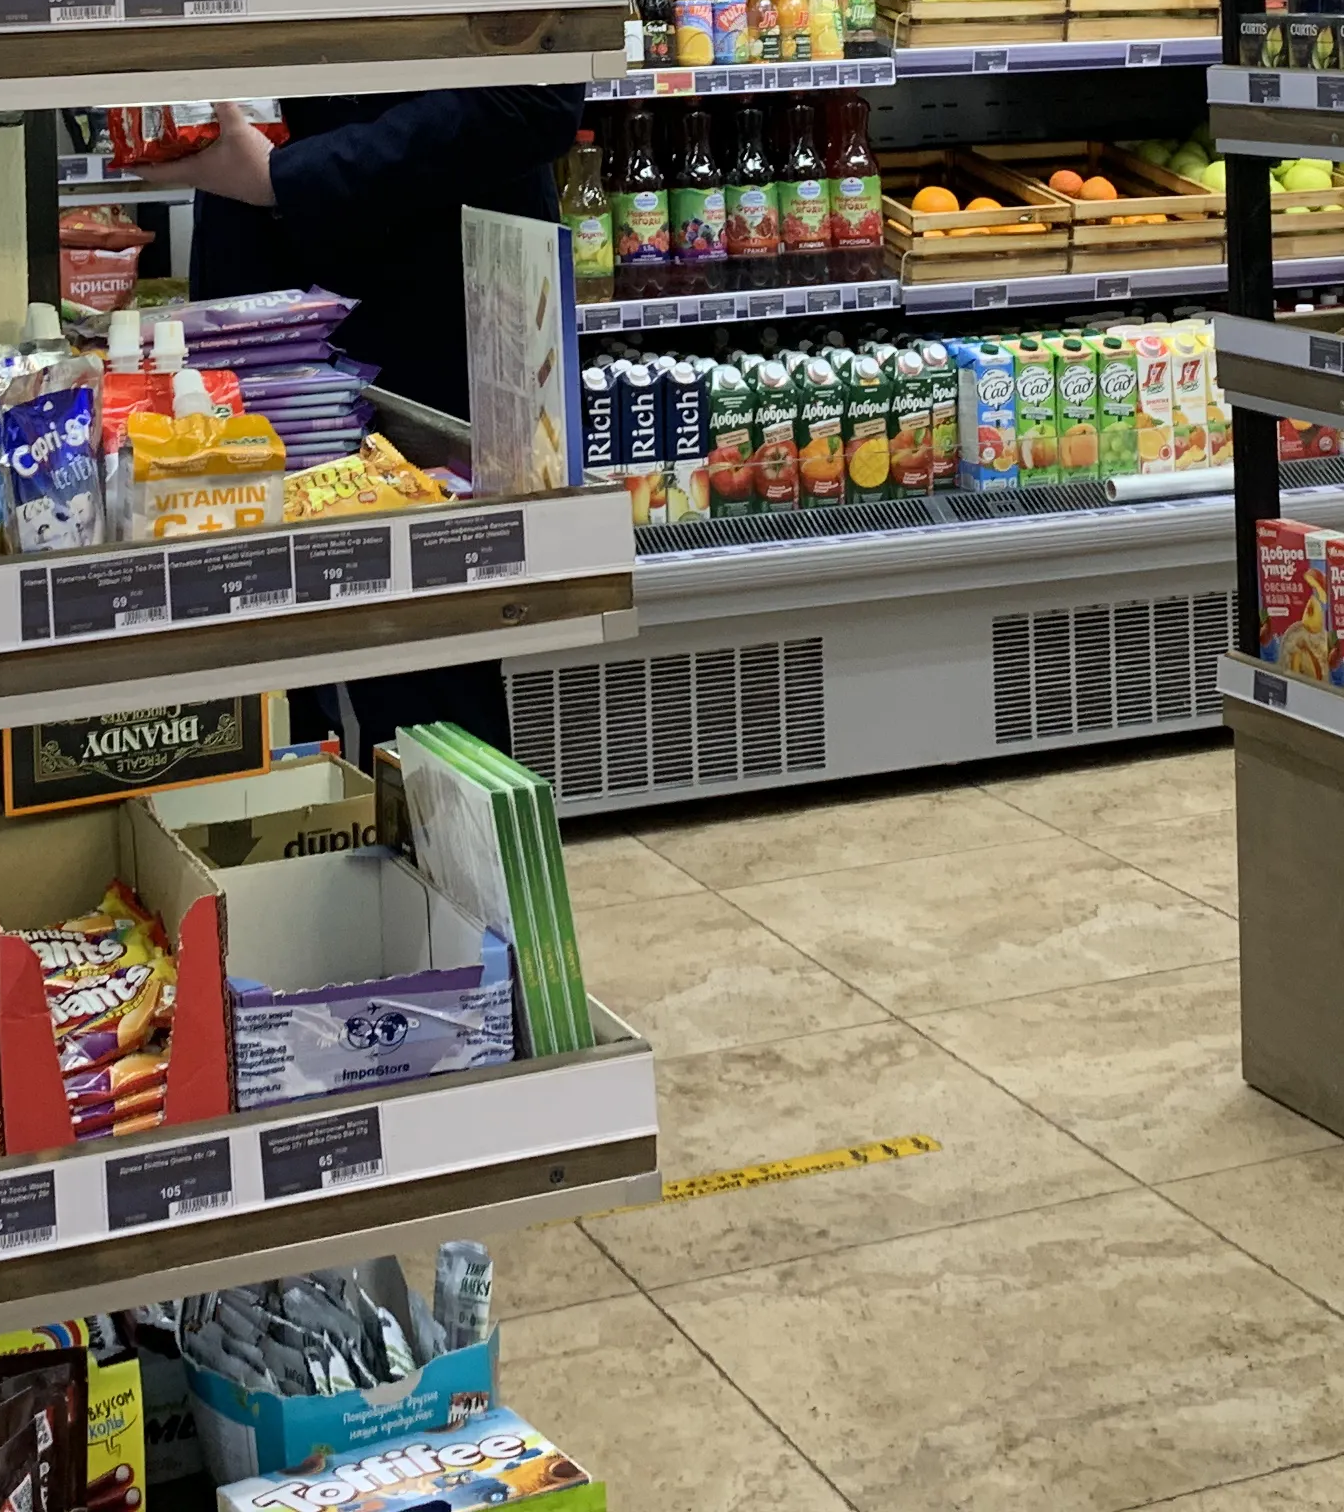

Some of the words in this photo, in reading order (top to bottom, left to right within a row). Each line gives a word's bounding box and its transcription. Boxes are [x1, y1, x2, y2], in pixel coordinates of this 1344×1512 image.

[1240, 22, 1267, 37] CURTIS
[1290, 22, 1318, 37] CURTIS
[69, 276, 134, 298] криспы
[802, 399, 844, 420] Добрый
[847, 397, 890, 417] Добрый
[892, 388, 933, 412] Добрый
[677, 390, 700, 456] Rich
[710, 408, 753, 428] Добрый
[755, 404, 798, 425] Добрый
[587, 396, 612, 463] Rich
[631, 392, 654, 459] Rich
[153, 483, 267, 510] VITAMIN
[1261, 547, 1304, 561] Доброе
[323, 568, 343, 580] 199
[222, 580, 242, 592] 199
[1265, 583, 1304, 593] овсяная
[1265, 594, 1290, 605] каша
[83, 714, 199, 758] BRANDY
[254, 1432, 525, 1512] Toffifee
